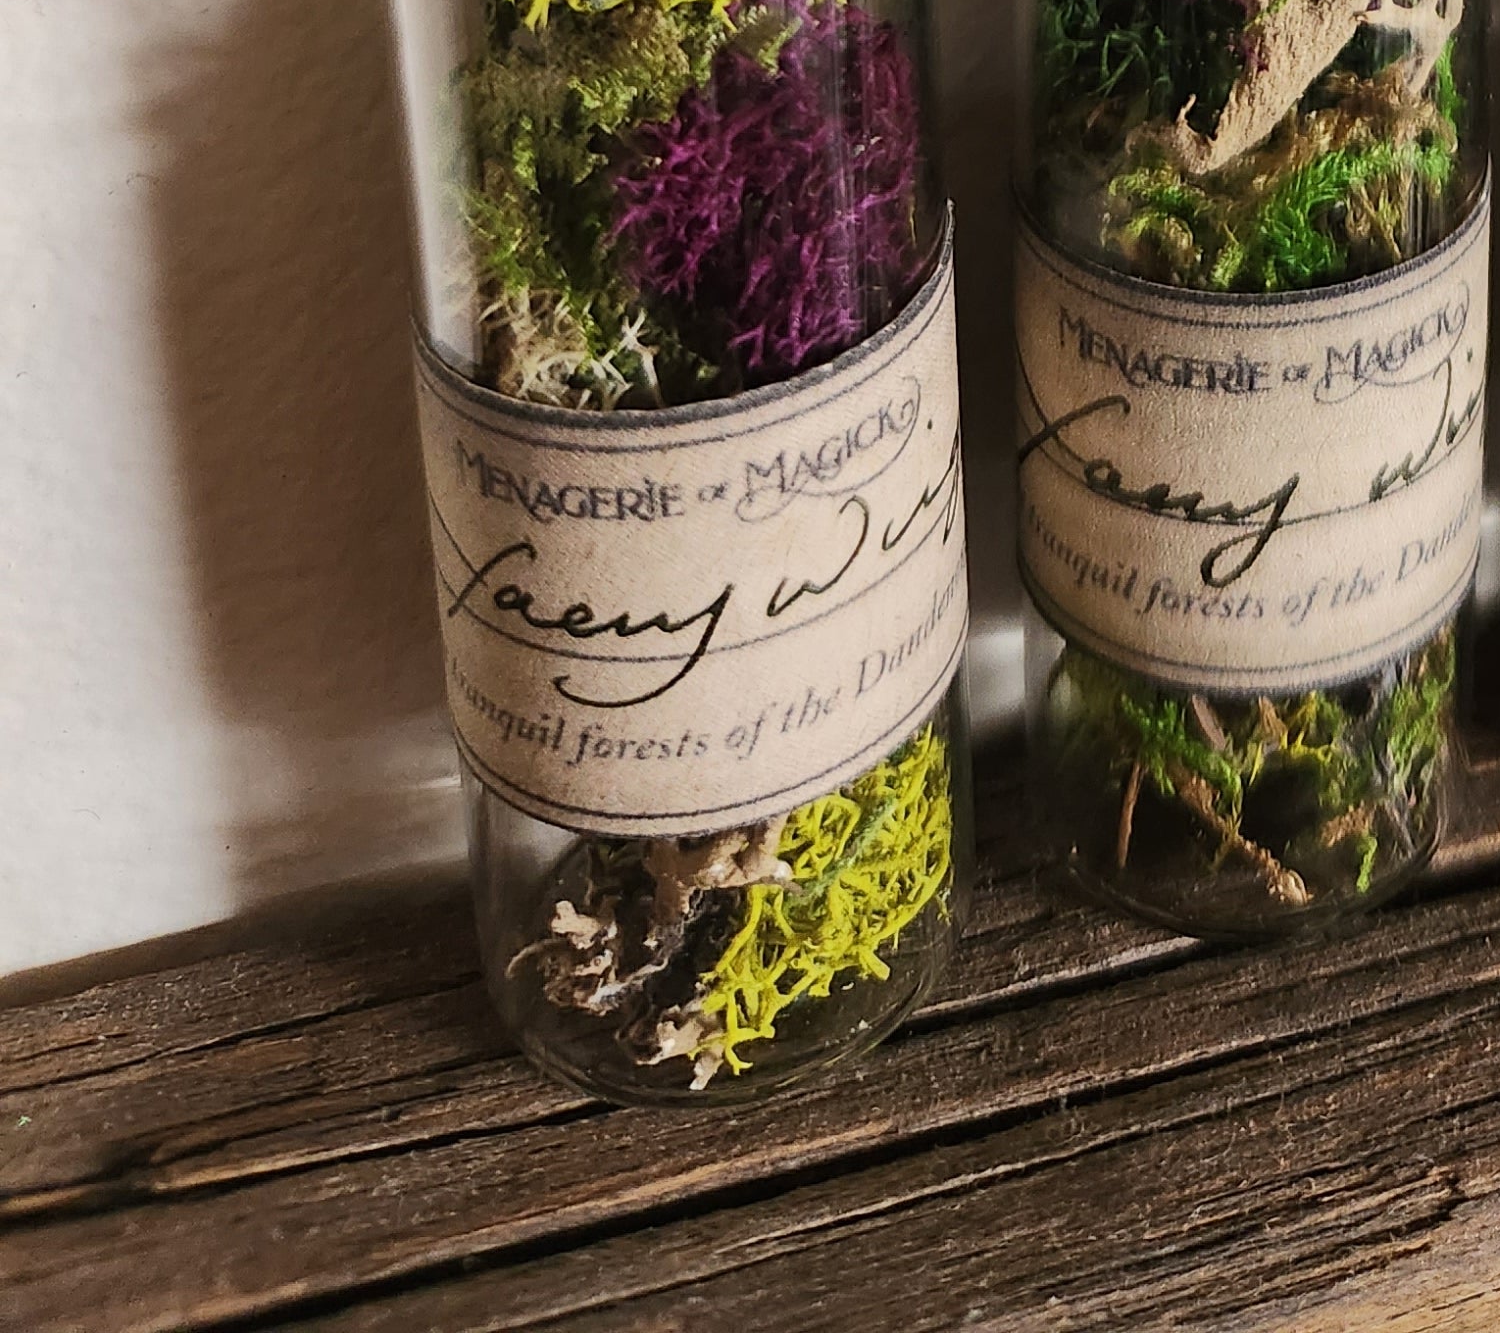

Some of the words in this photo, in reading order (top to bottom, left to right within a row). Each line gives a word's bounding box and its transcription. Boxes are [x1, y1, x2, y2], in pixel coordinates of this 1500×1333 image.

[1057, 303, 1272, 395] MENAGERIE
[453, 436, 686, 524] MENAGERIE
[734, 374, 922, 523] MAGICK
[1133, 575, 1266, 619] forests
[1281, 575, 1328, 629] of
[1329, 564, 1386, 610] the
[565, 722, 711, 770] forests
[724, 701, 778, 762] of
[781, 686, 842, 735] the
